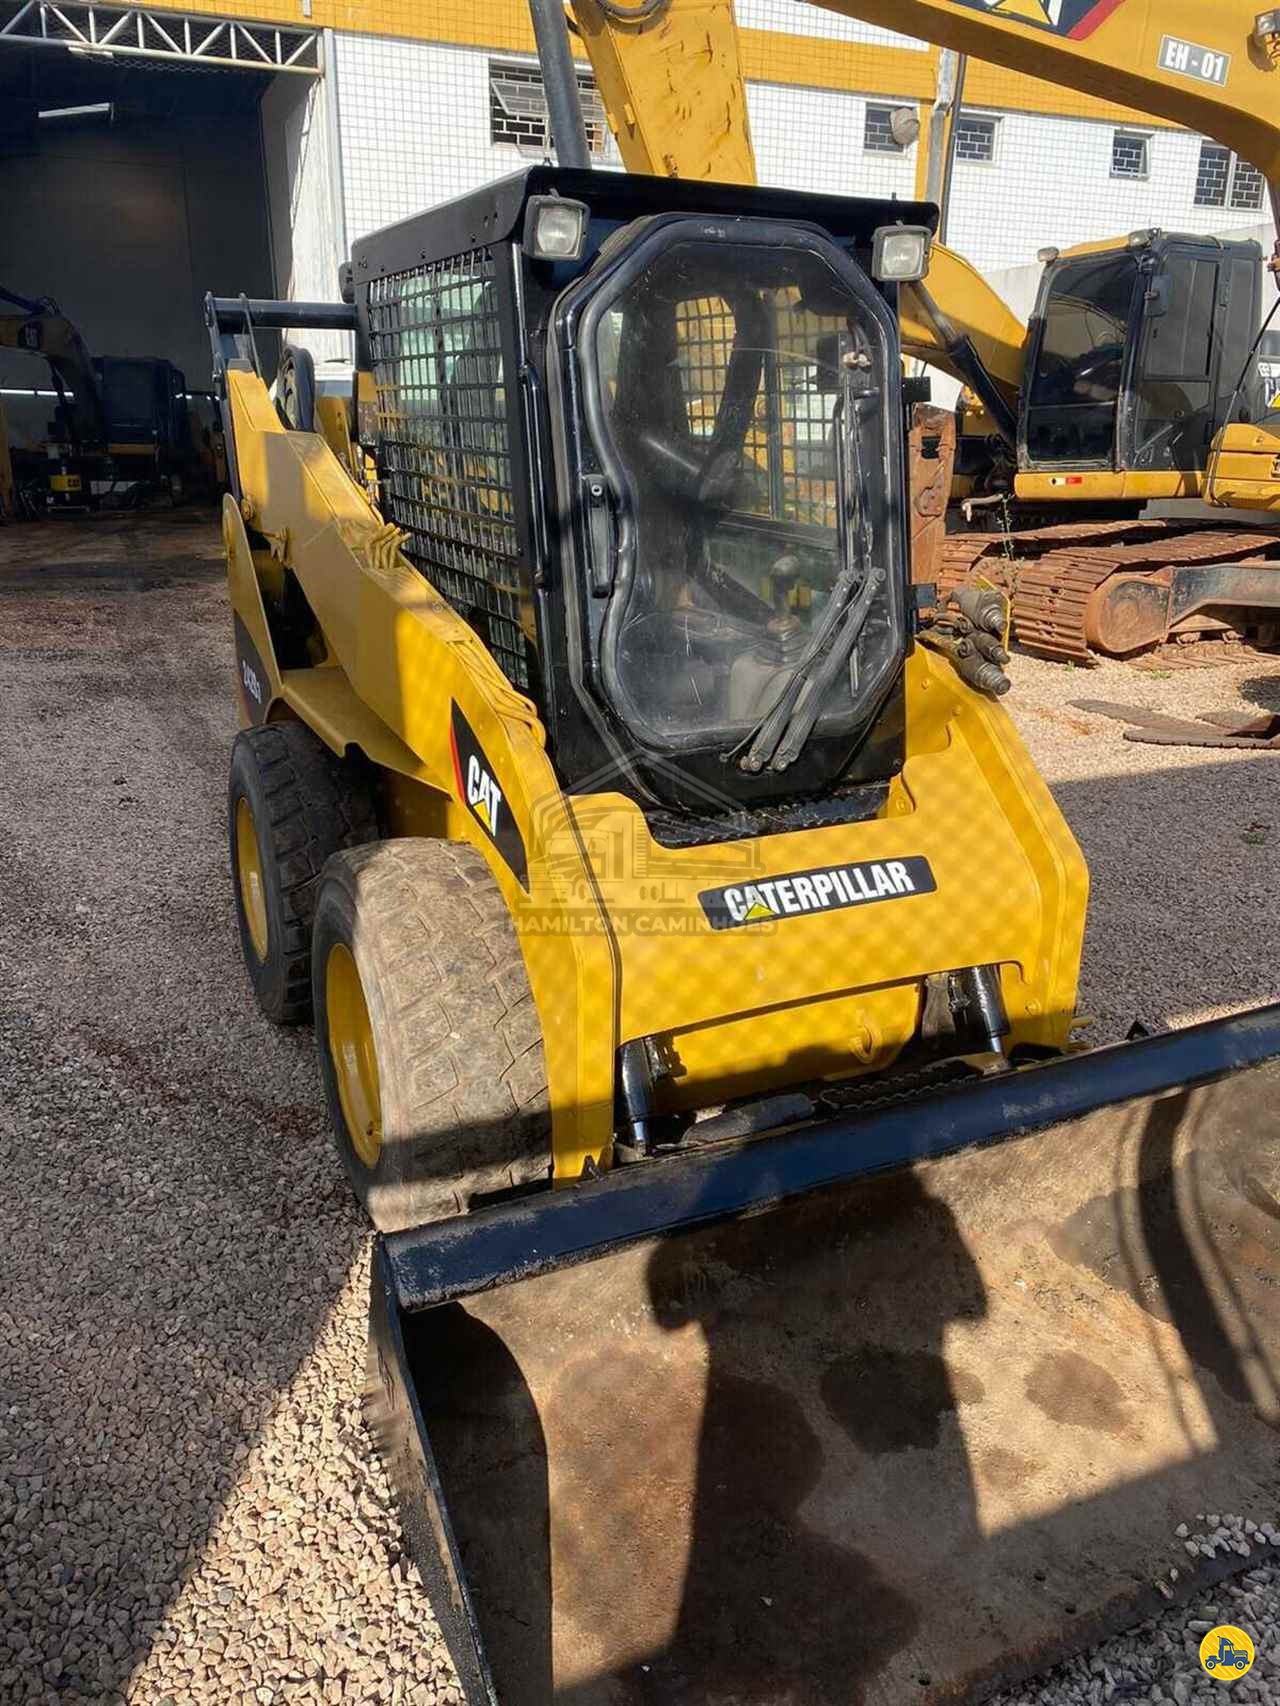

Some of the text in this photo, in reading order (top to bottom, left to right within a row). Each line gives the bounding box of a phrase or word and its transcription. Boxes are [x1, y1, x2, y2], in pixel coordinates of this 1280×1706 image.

[1164, 39, 1190, 71] EH
[1200, 53, 1225, 82] 01
[467, 754, 502, 837] CAT
[723, 859, 916, 924] CATERPILLAR
